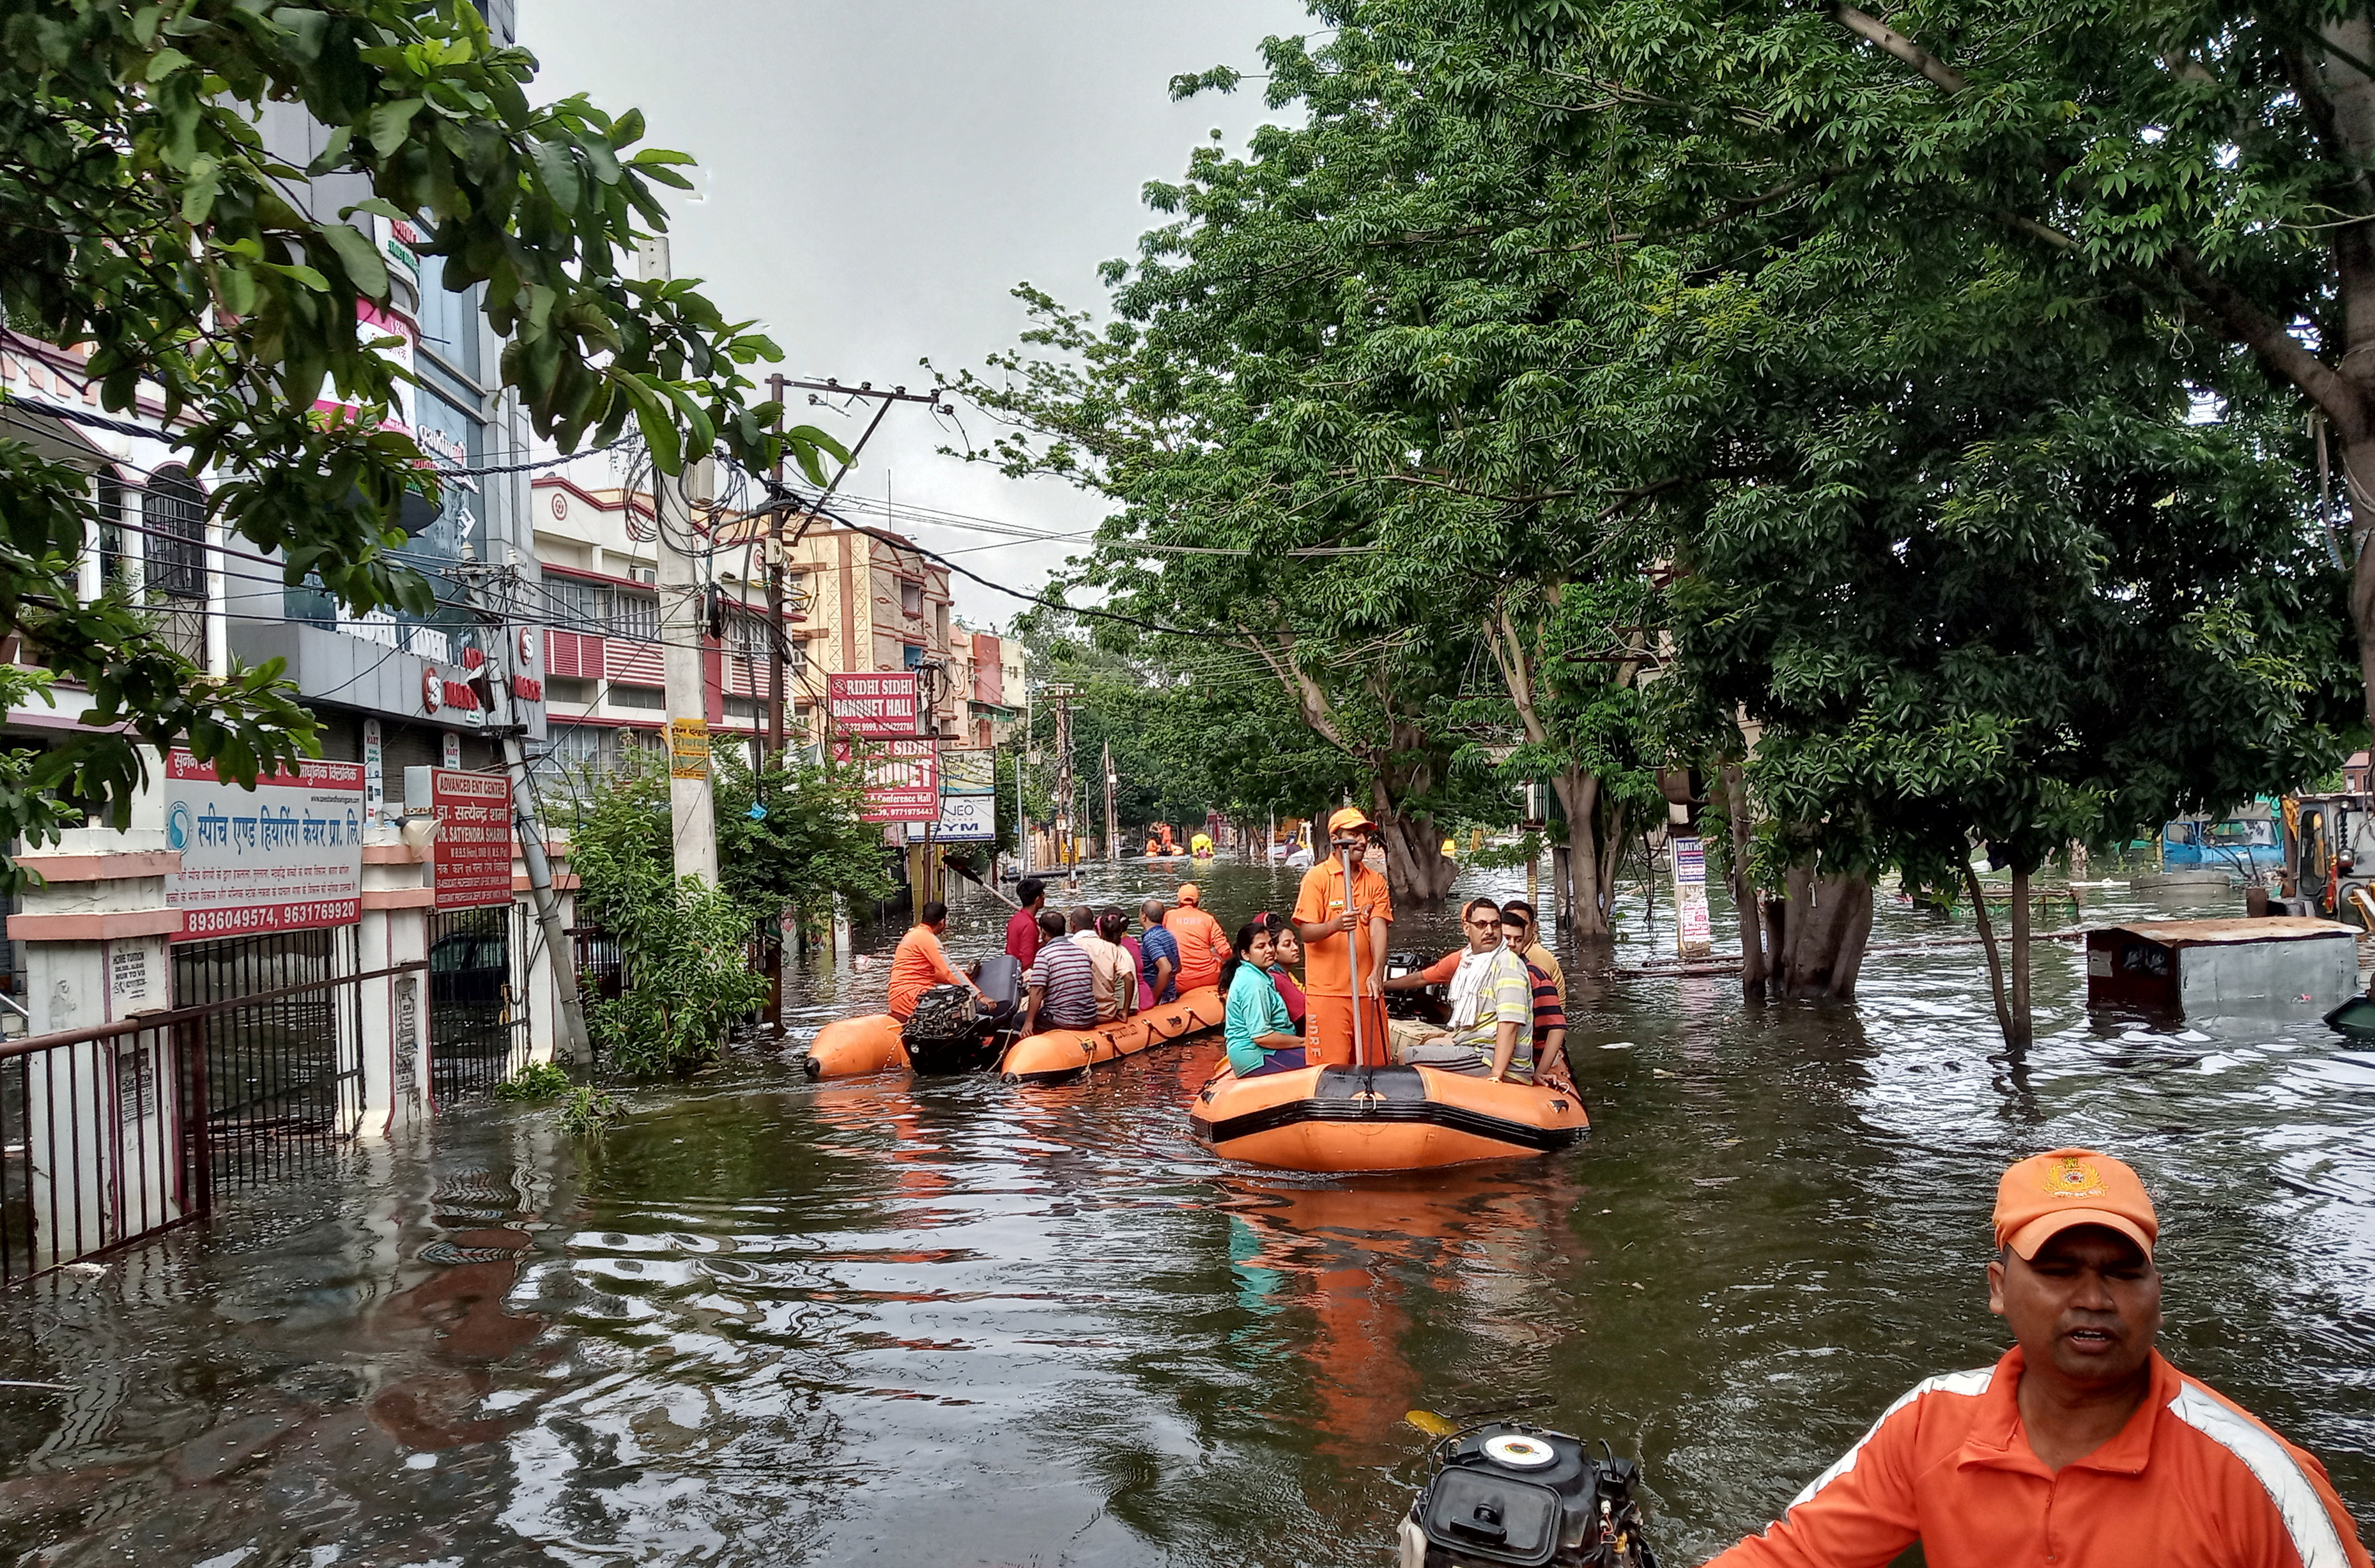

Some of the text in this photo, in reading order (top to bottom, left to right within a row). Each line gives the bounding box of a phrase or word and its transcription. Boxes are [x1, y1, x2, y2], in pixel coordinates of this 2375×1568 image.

[847, 679, 912, 695] RIDHI SIDHI
[833, 699, 912, 718] BANQUET HALL
[893, 740, 933, 755] SIDHI
[440, 776, 505, 796] ADVANCED ENT CENTRE
[877, 793, 916, 803] Conference
[918, 792, 931, 803] Hall
[489, 803, 508, 822] शर्मा
[891, 808, 934, 817] 9771975443
[197, 803, 360, 855] स्पीच एण्ड हियरिंग केयर प्रा. लि.
[449, 826, 485, 843] SATYENDRA
[486, 827, 509, 843] SHARMA
[188, 900, 355, 933] 8936049574, 9631769920
[1307, 1014, 1322, 1057] NDRF
